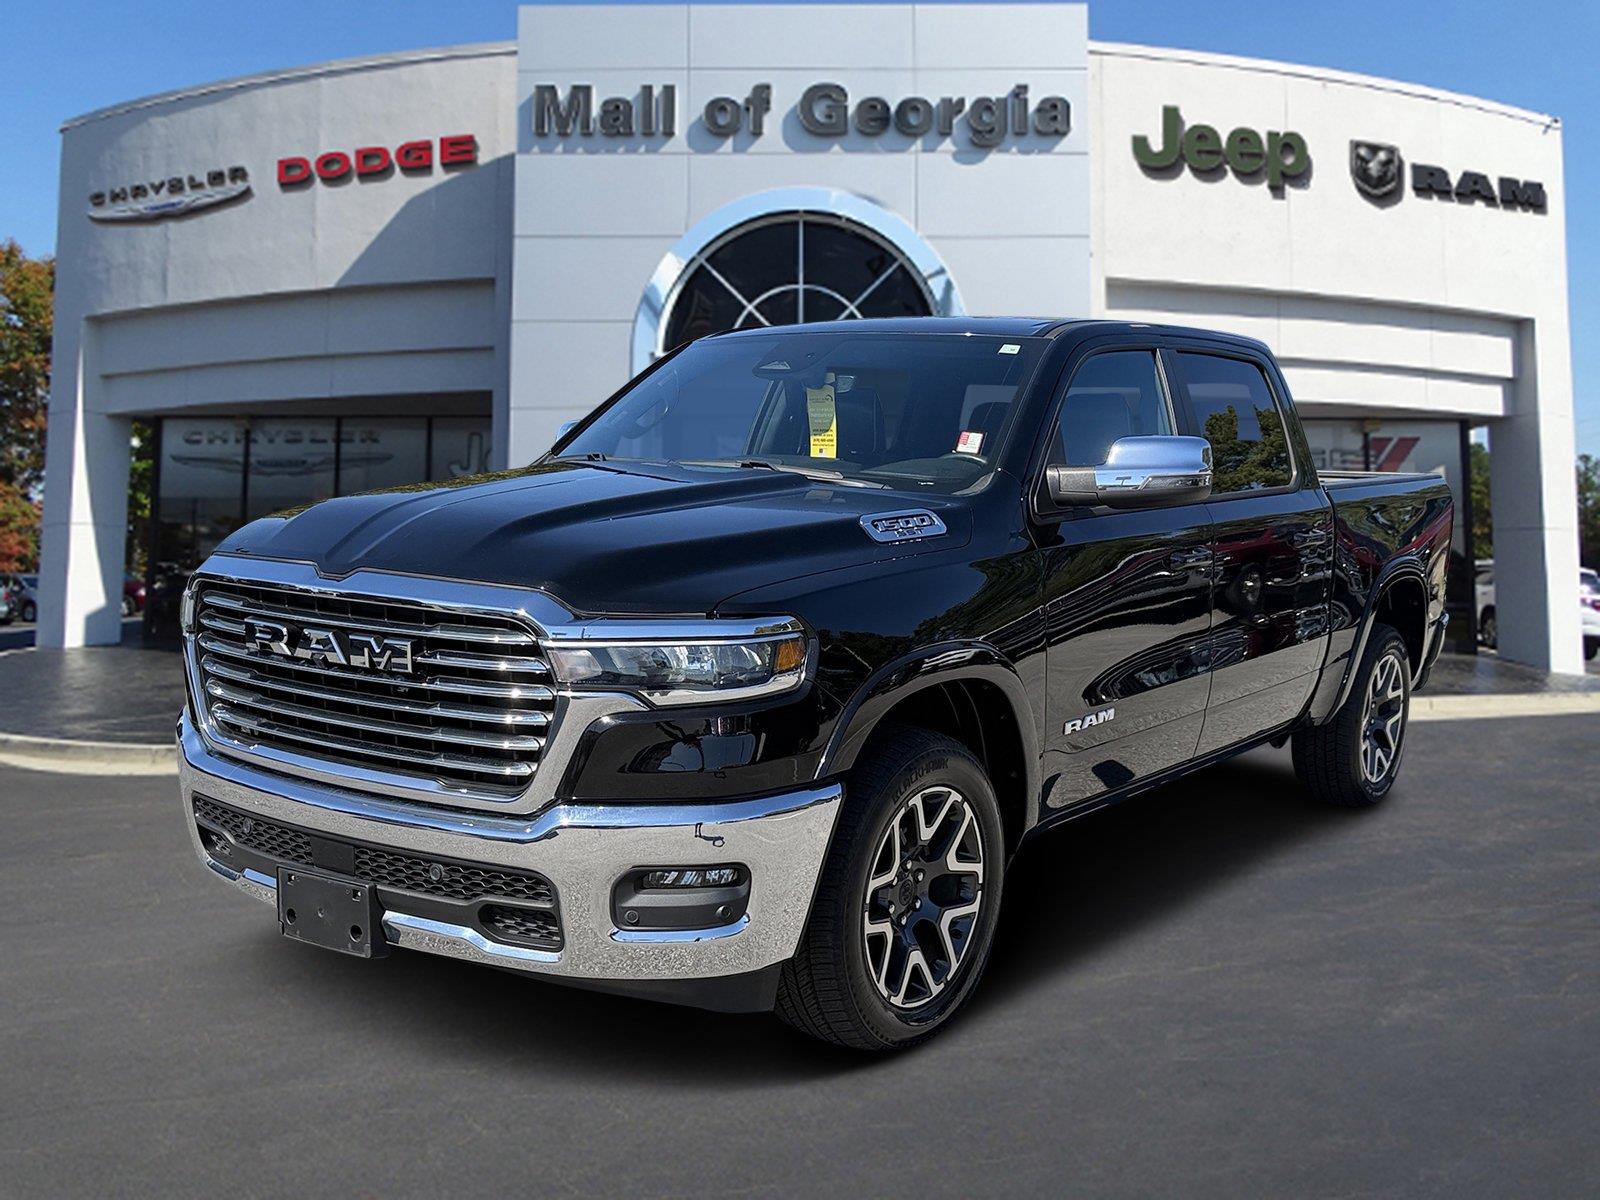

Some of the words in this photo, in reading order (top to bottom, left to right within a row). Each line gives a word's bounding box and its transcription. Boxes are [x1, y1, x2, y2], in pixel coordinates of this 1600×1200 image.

[532, 84, 677, 136] Mall
[703, 84, 773, 136] of
[799, 82, 1074, 147] Georgia
[277, 134, 478, 189] DODGE
[1132, 105, 1310, 198] Jeep
[89, 166, 250, 206] CHRYSLER
[1411, 162, 1548, 214] RAM
[183, 430, 381, 445] CHRYSLER
[873, 516, 932, 534] 1500
[244, 615, 414, 673] RAM
[1063, 707, 1115, 735] RAM
